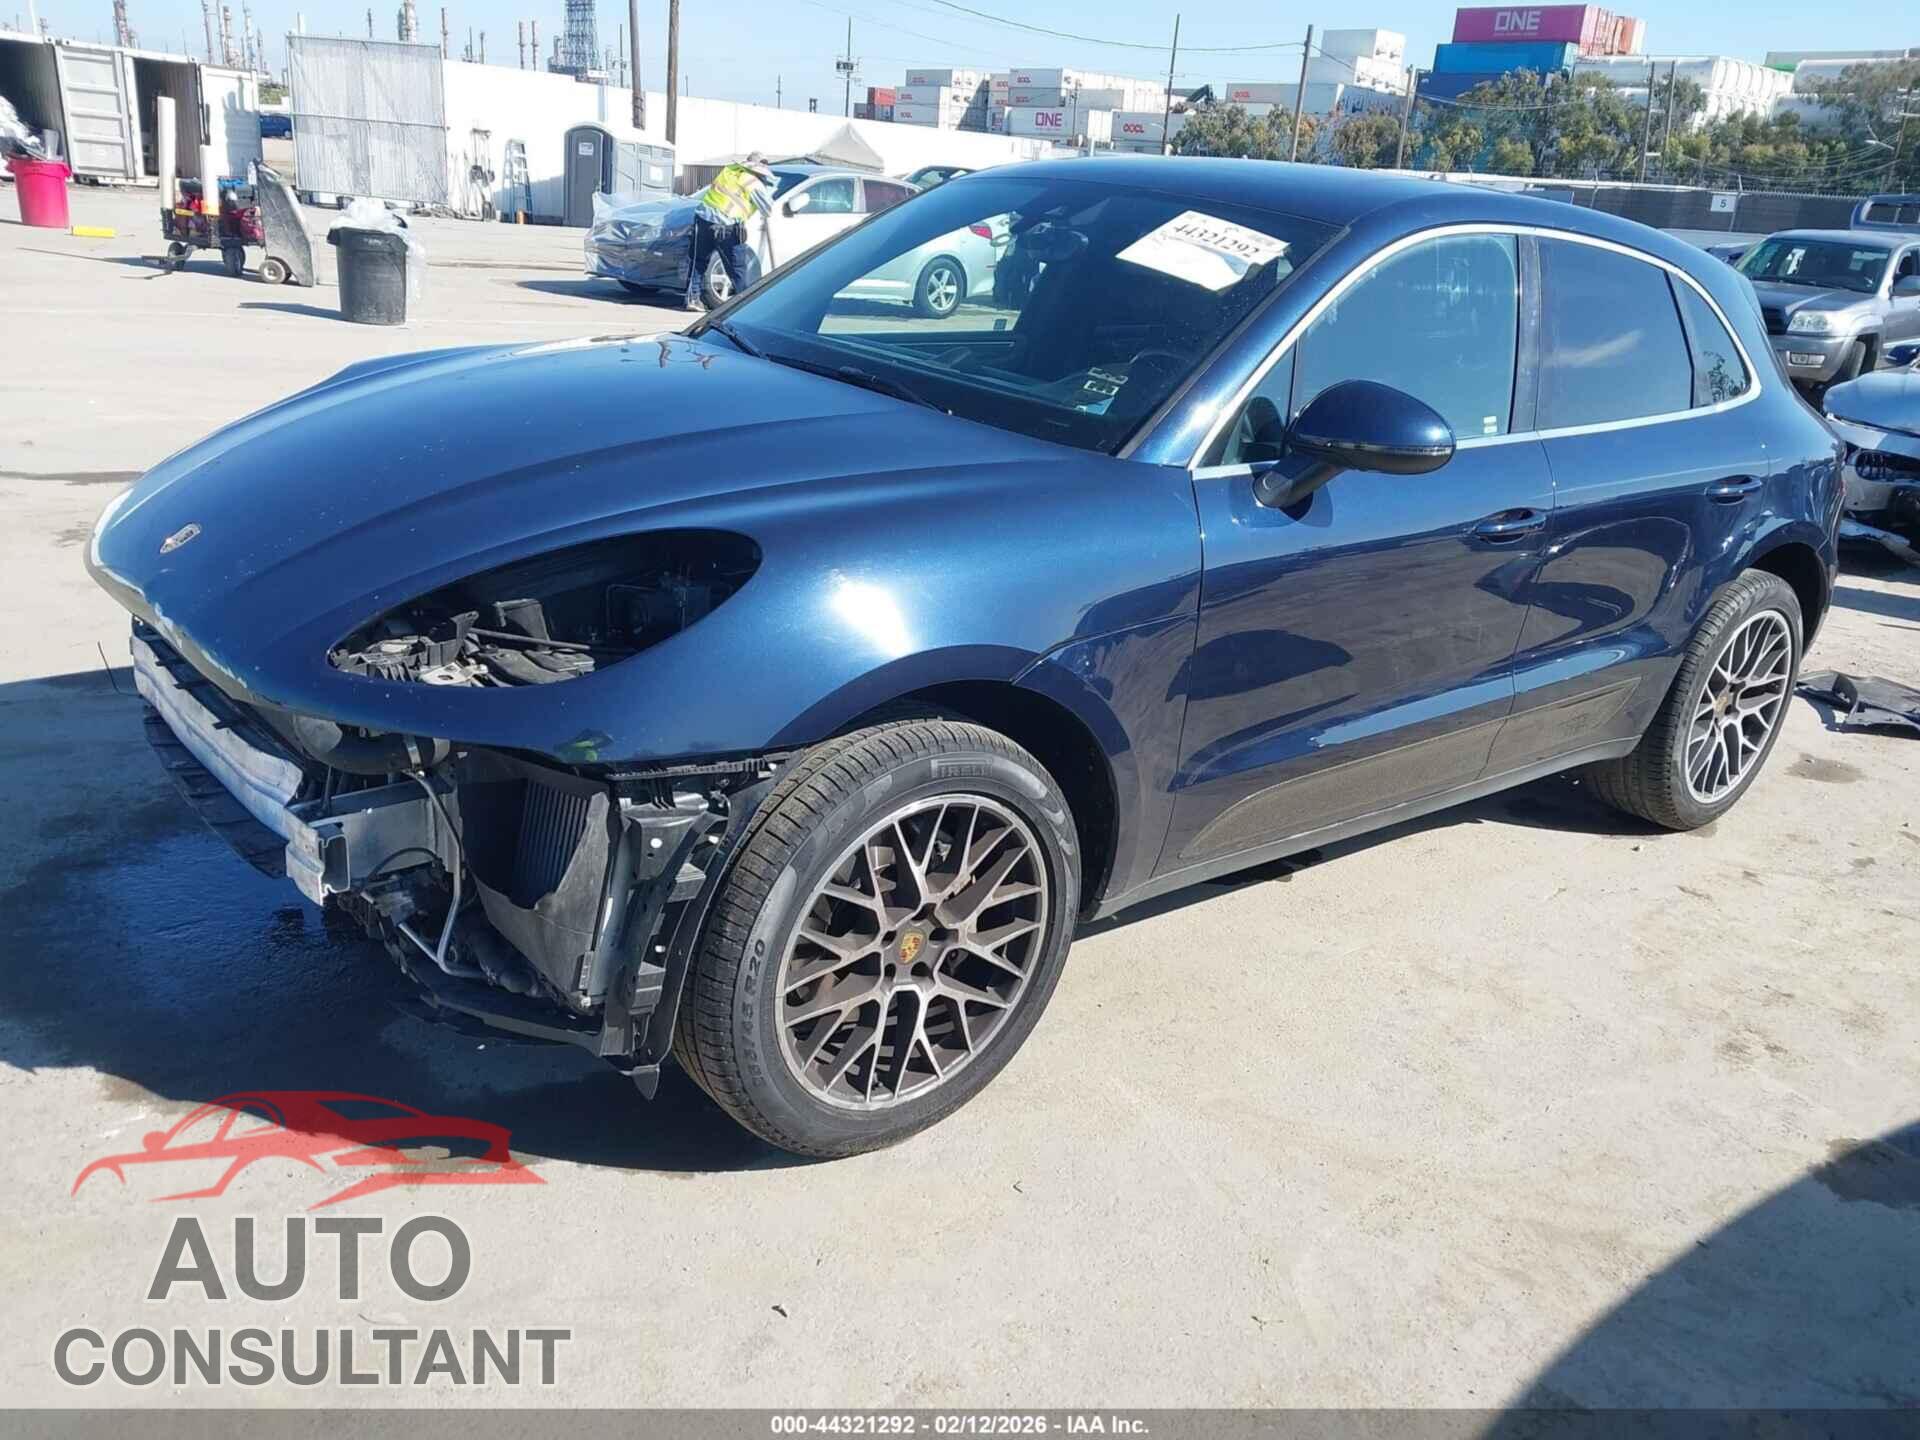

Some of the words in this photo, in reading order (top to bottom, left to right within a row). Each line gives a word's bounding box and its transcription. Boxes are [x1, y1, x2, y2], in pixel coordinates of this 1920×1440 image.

[1494, 11, 1541, 31] ONE
[1034, 111, 1063, 127] ONE
[1719, 199, 1727, 209] 5
[1173, 223, 1261, 258] 44321292
